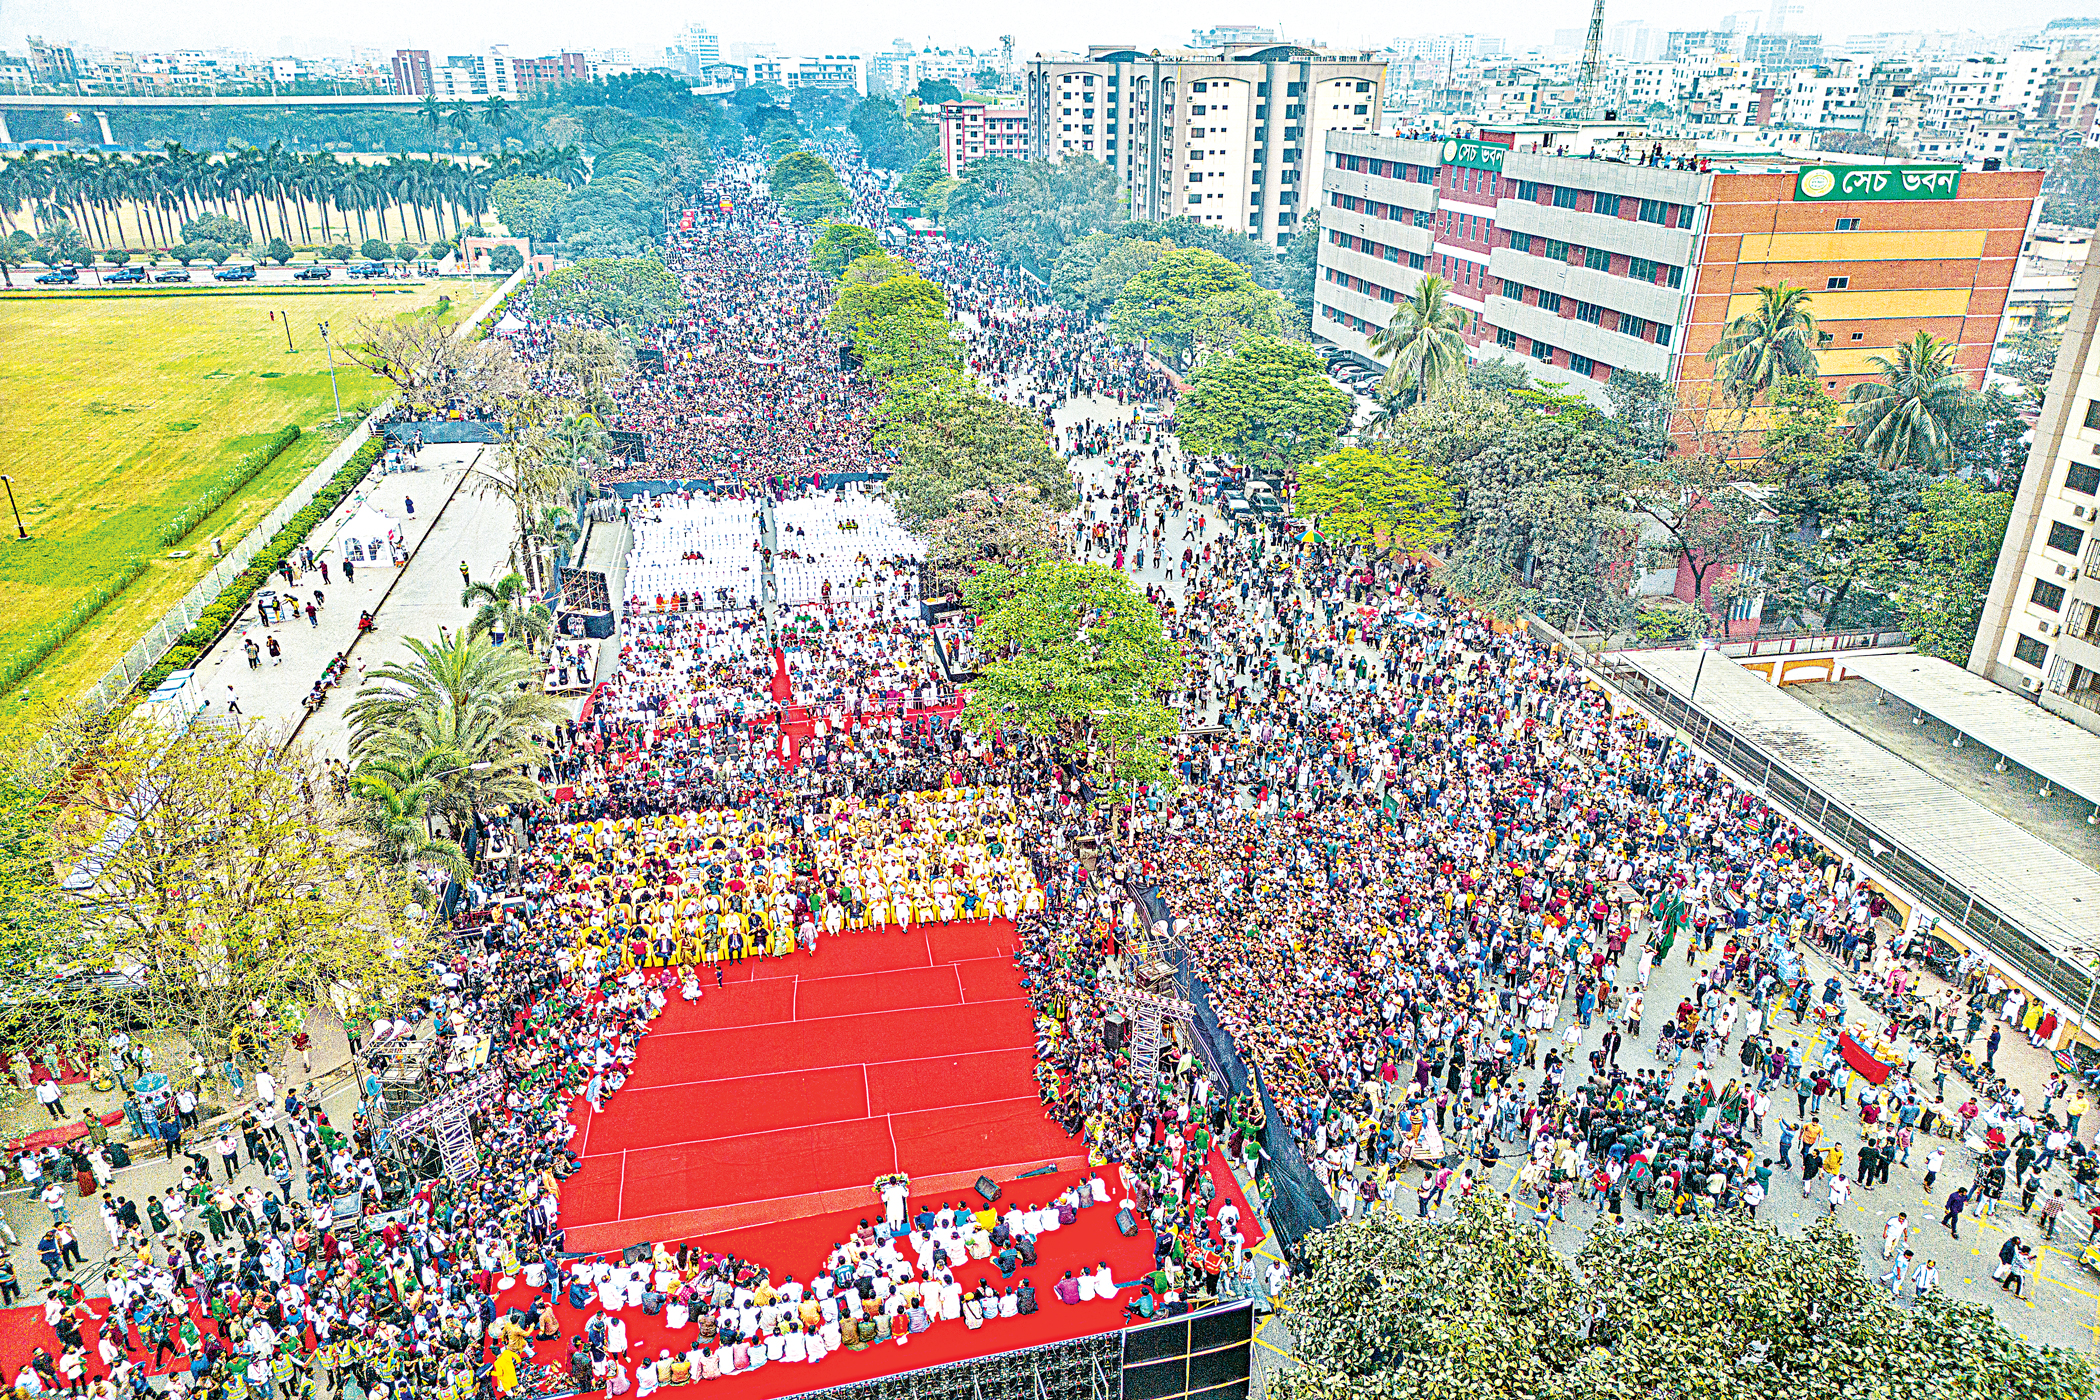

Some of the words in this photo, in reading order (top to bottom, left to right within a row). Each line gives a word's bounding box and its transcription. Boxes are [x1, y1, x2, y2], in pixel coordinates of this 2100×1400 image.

[1458, 143, 1480, 162] সেচ
[1481, 145, 1506, 167] ভবন
[1842, 170, 1892, 194] সেচ
[1900, 170, 1960, 194] ভবন
[840, 1271, 852, 1283] 10
